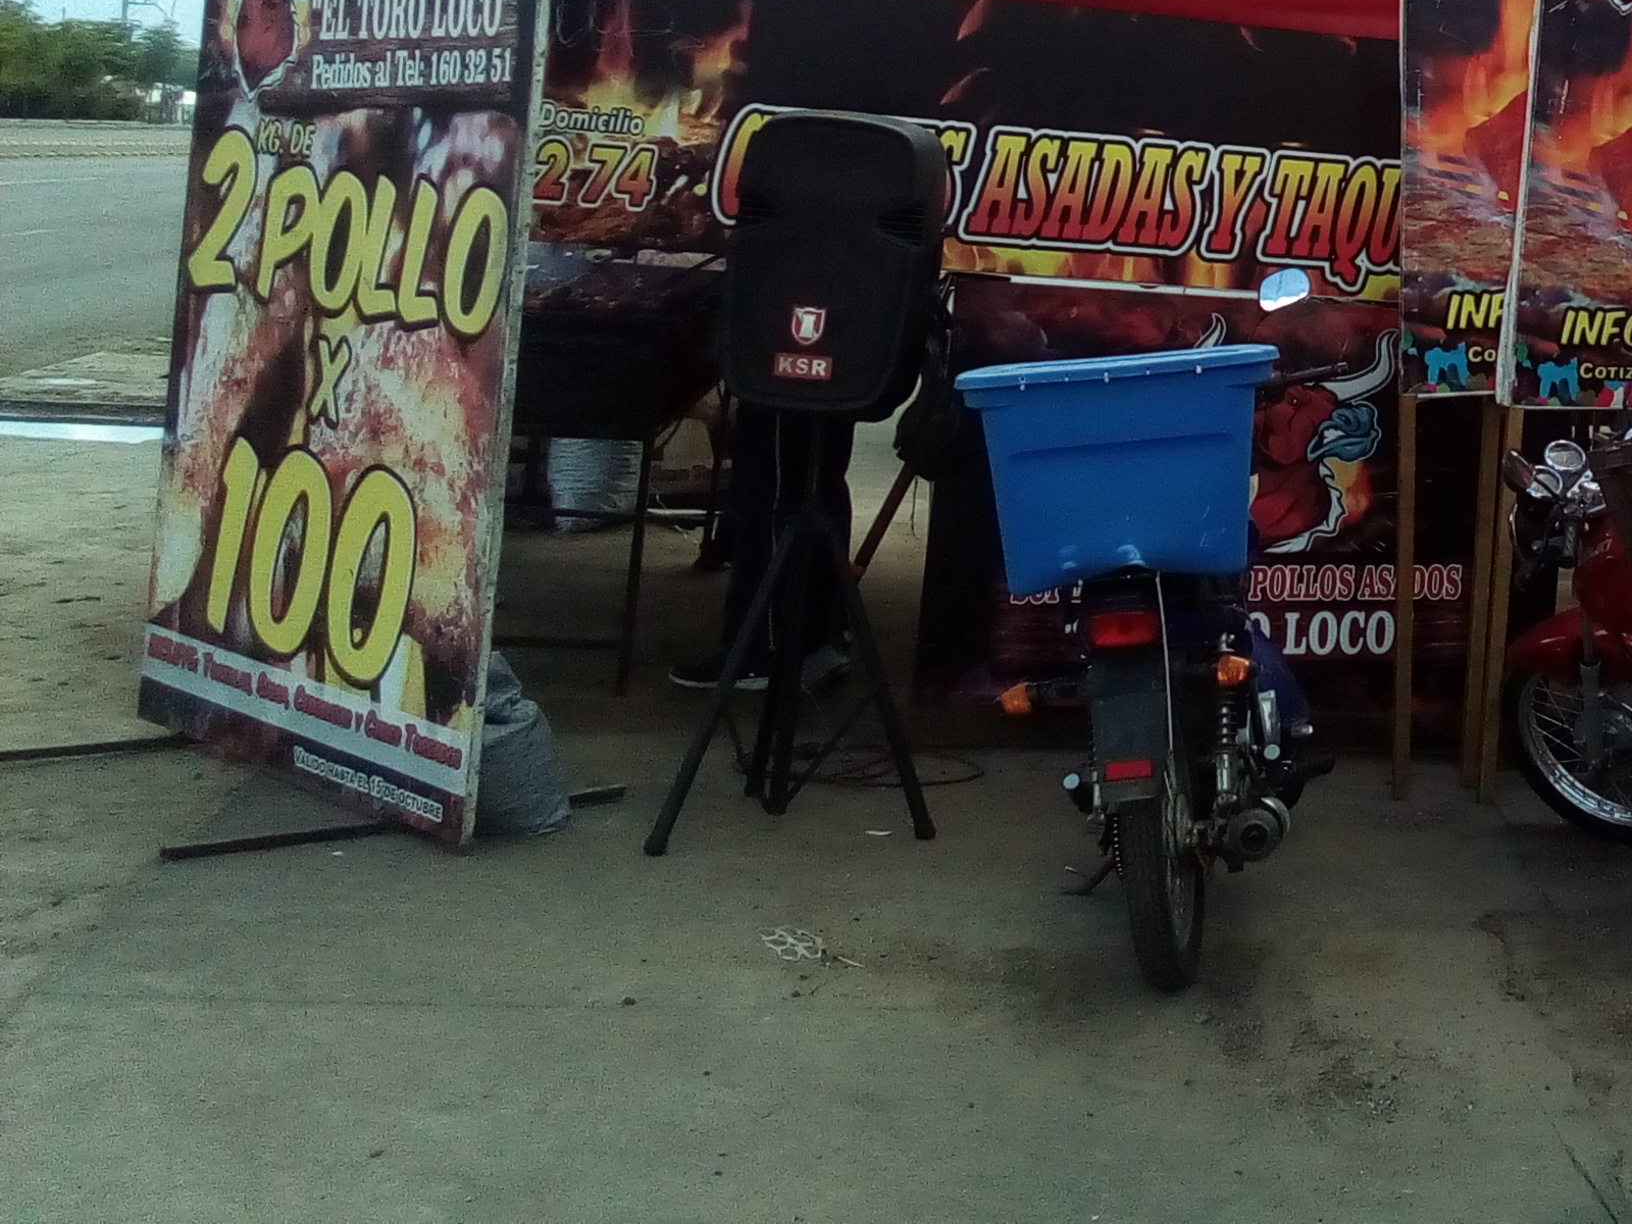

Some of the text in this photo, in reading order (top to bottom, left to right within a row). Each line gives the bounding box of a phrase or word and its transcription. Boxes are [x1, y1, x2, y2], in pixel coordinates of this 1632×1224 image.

[310, 47, 513, 90] Pedidos al Tel: 160 32 51
[257, 118, 316, 156] KG. DE
[541, 98, 645, 136] Domicilio
[964, 128, 1208, 250] ASADAS
[1206, 150, 1264, 258] Y
[187, 125, 257, 291] 2
[257, 163, 509, 338] POLLO
[778, 356, 827, 376] KSR
[205, 435, 416, 683] 100
[1248, 563, 1463, 602] POLLOS ASDOS
[1282, 610, 1397, 656] LOCO
[396, 788, 444, 823] OCTUBRE
